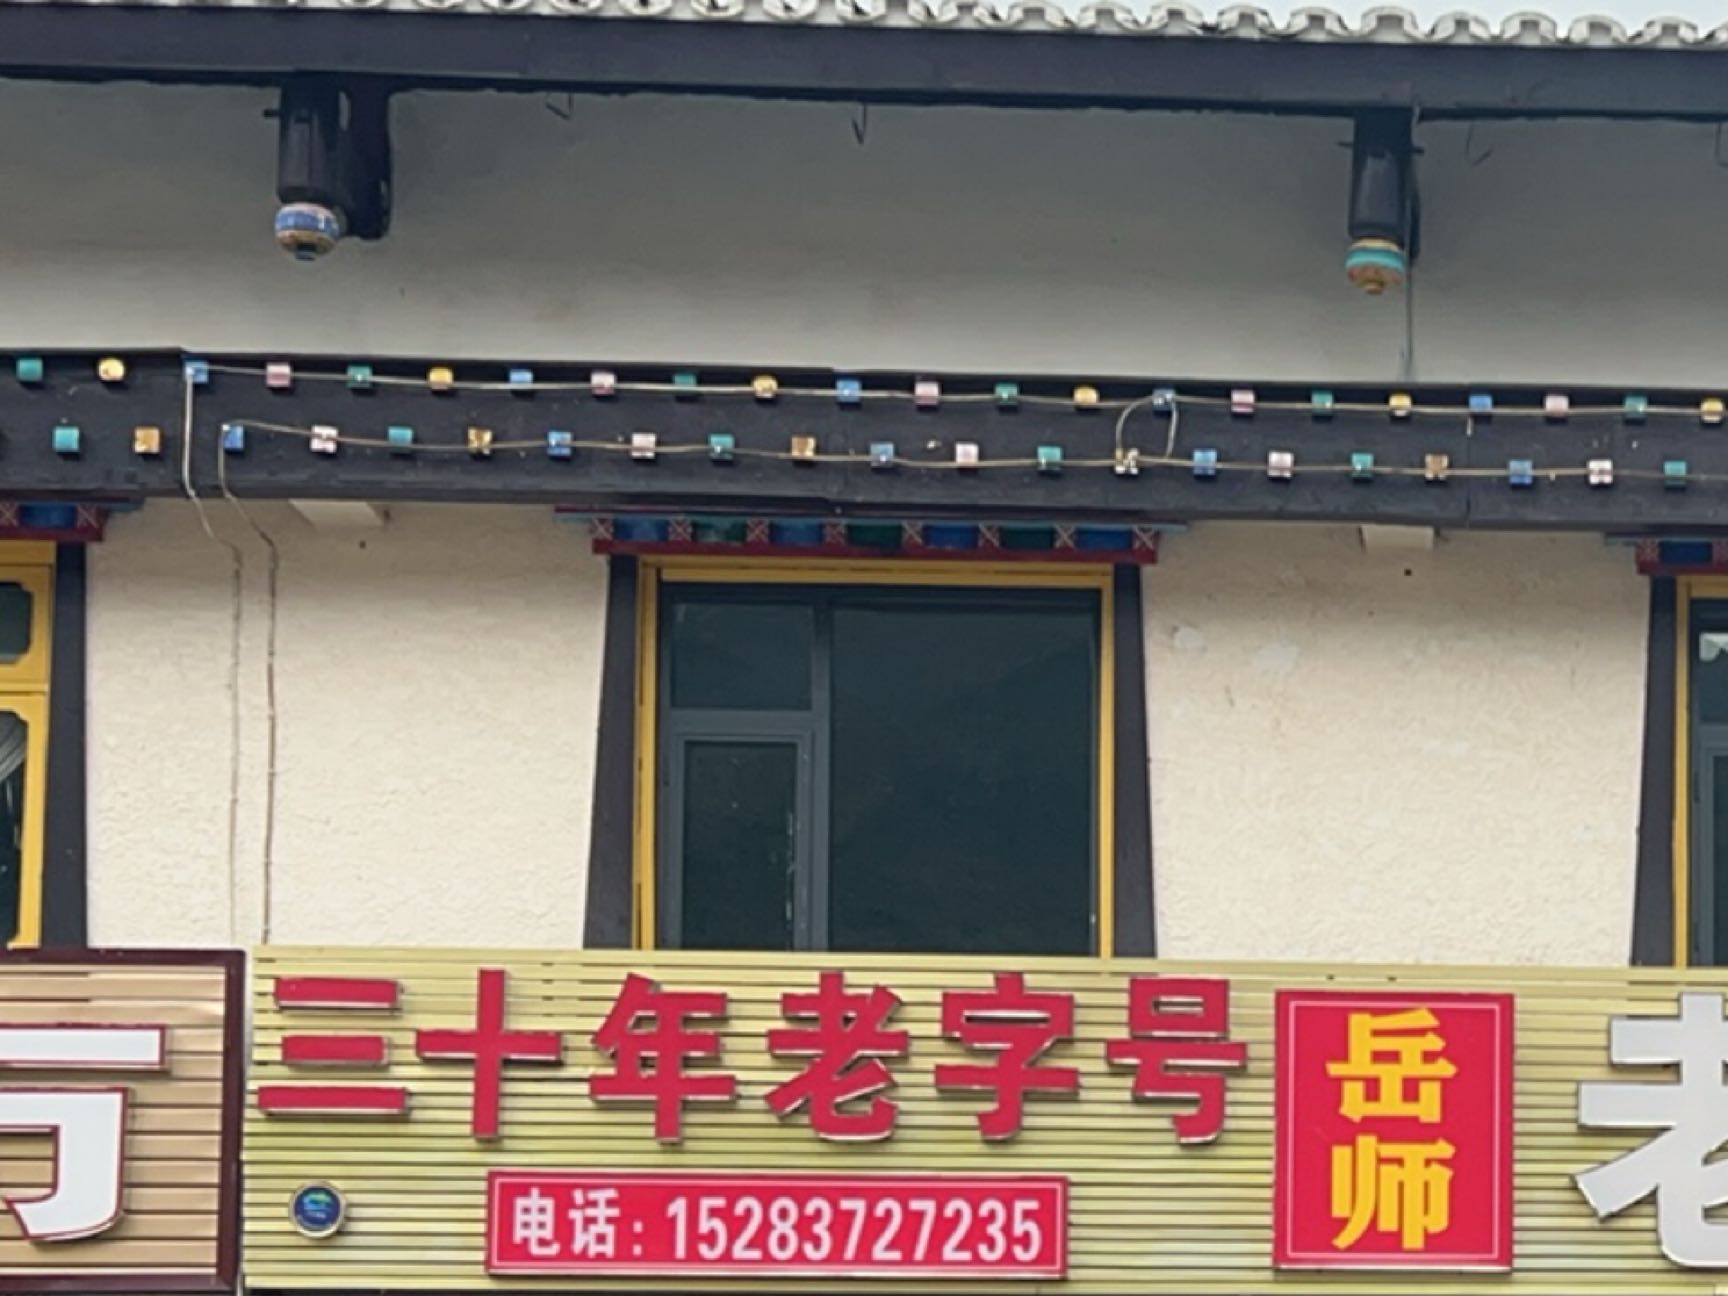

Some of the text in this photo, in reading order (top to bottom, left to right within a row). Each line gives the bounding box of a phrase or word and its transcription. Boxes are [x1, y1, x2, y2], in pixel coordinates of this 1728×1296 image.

[258, 968, 1247, 1145] 三十年老字号
[1325, 1007, 1457, 1251] 岳师
